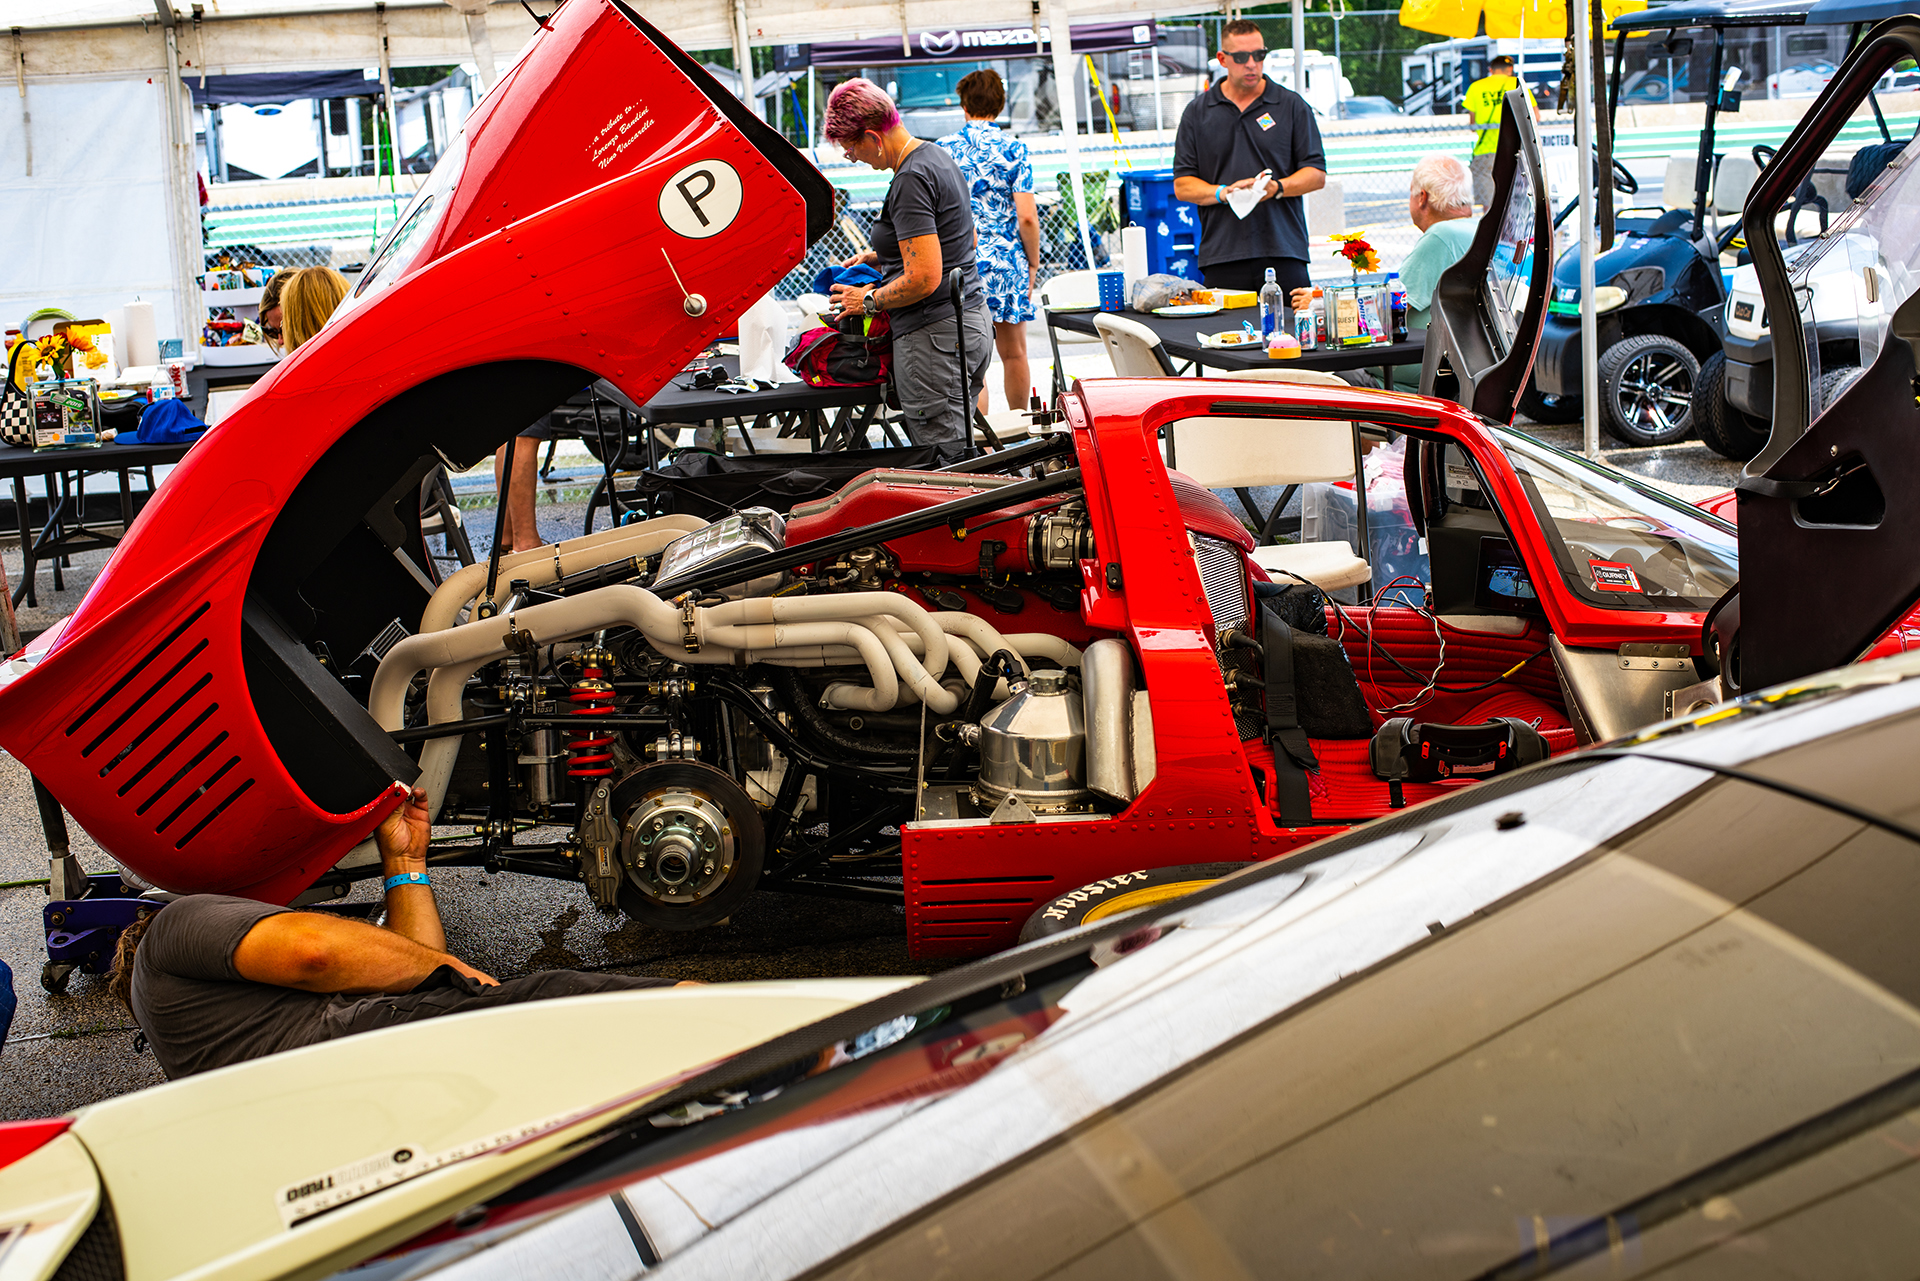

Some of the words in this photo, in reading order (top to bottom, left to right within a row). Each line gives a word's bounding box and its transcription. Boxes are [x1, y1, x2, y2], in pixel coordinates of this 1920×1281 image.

[1482, 90, 1506, 98] EVE
[592, 135, 619, 162] Lorenzo
[619, 106, 649, 134] Bandini
[598, 153, 617, 169] Nino
[616, 119, 655, 153] Vaccarella
[600, 119, 623, 136] tribute
[676, 169, 716, 228] P
[1042, 869, 1149, 921] Hoosier
